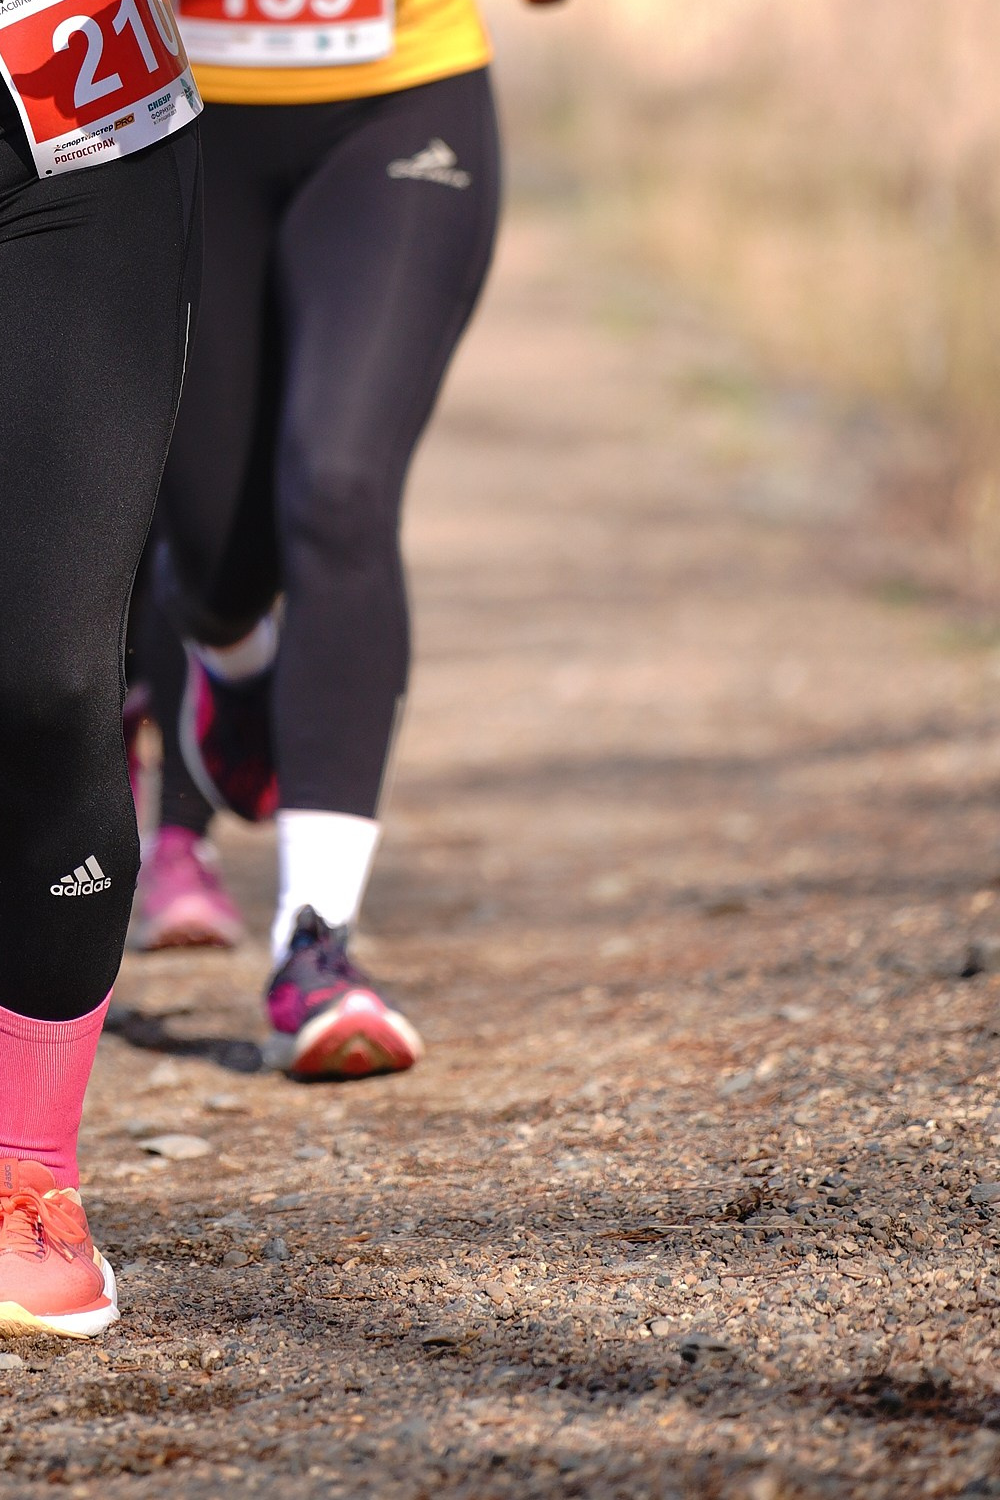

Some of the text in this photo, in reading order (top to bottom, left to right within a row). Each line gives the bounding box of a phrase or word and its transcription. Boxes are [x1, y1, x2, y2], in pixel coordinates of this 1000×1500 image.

[147, 92, 172, 112] СИБУР
[115, 115, 135, 131] PRO
[54, 136, 116, 165] РОСГОССТРАХ
[50, 877, 112, 897] adidas
